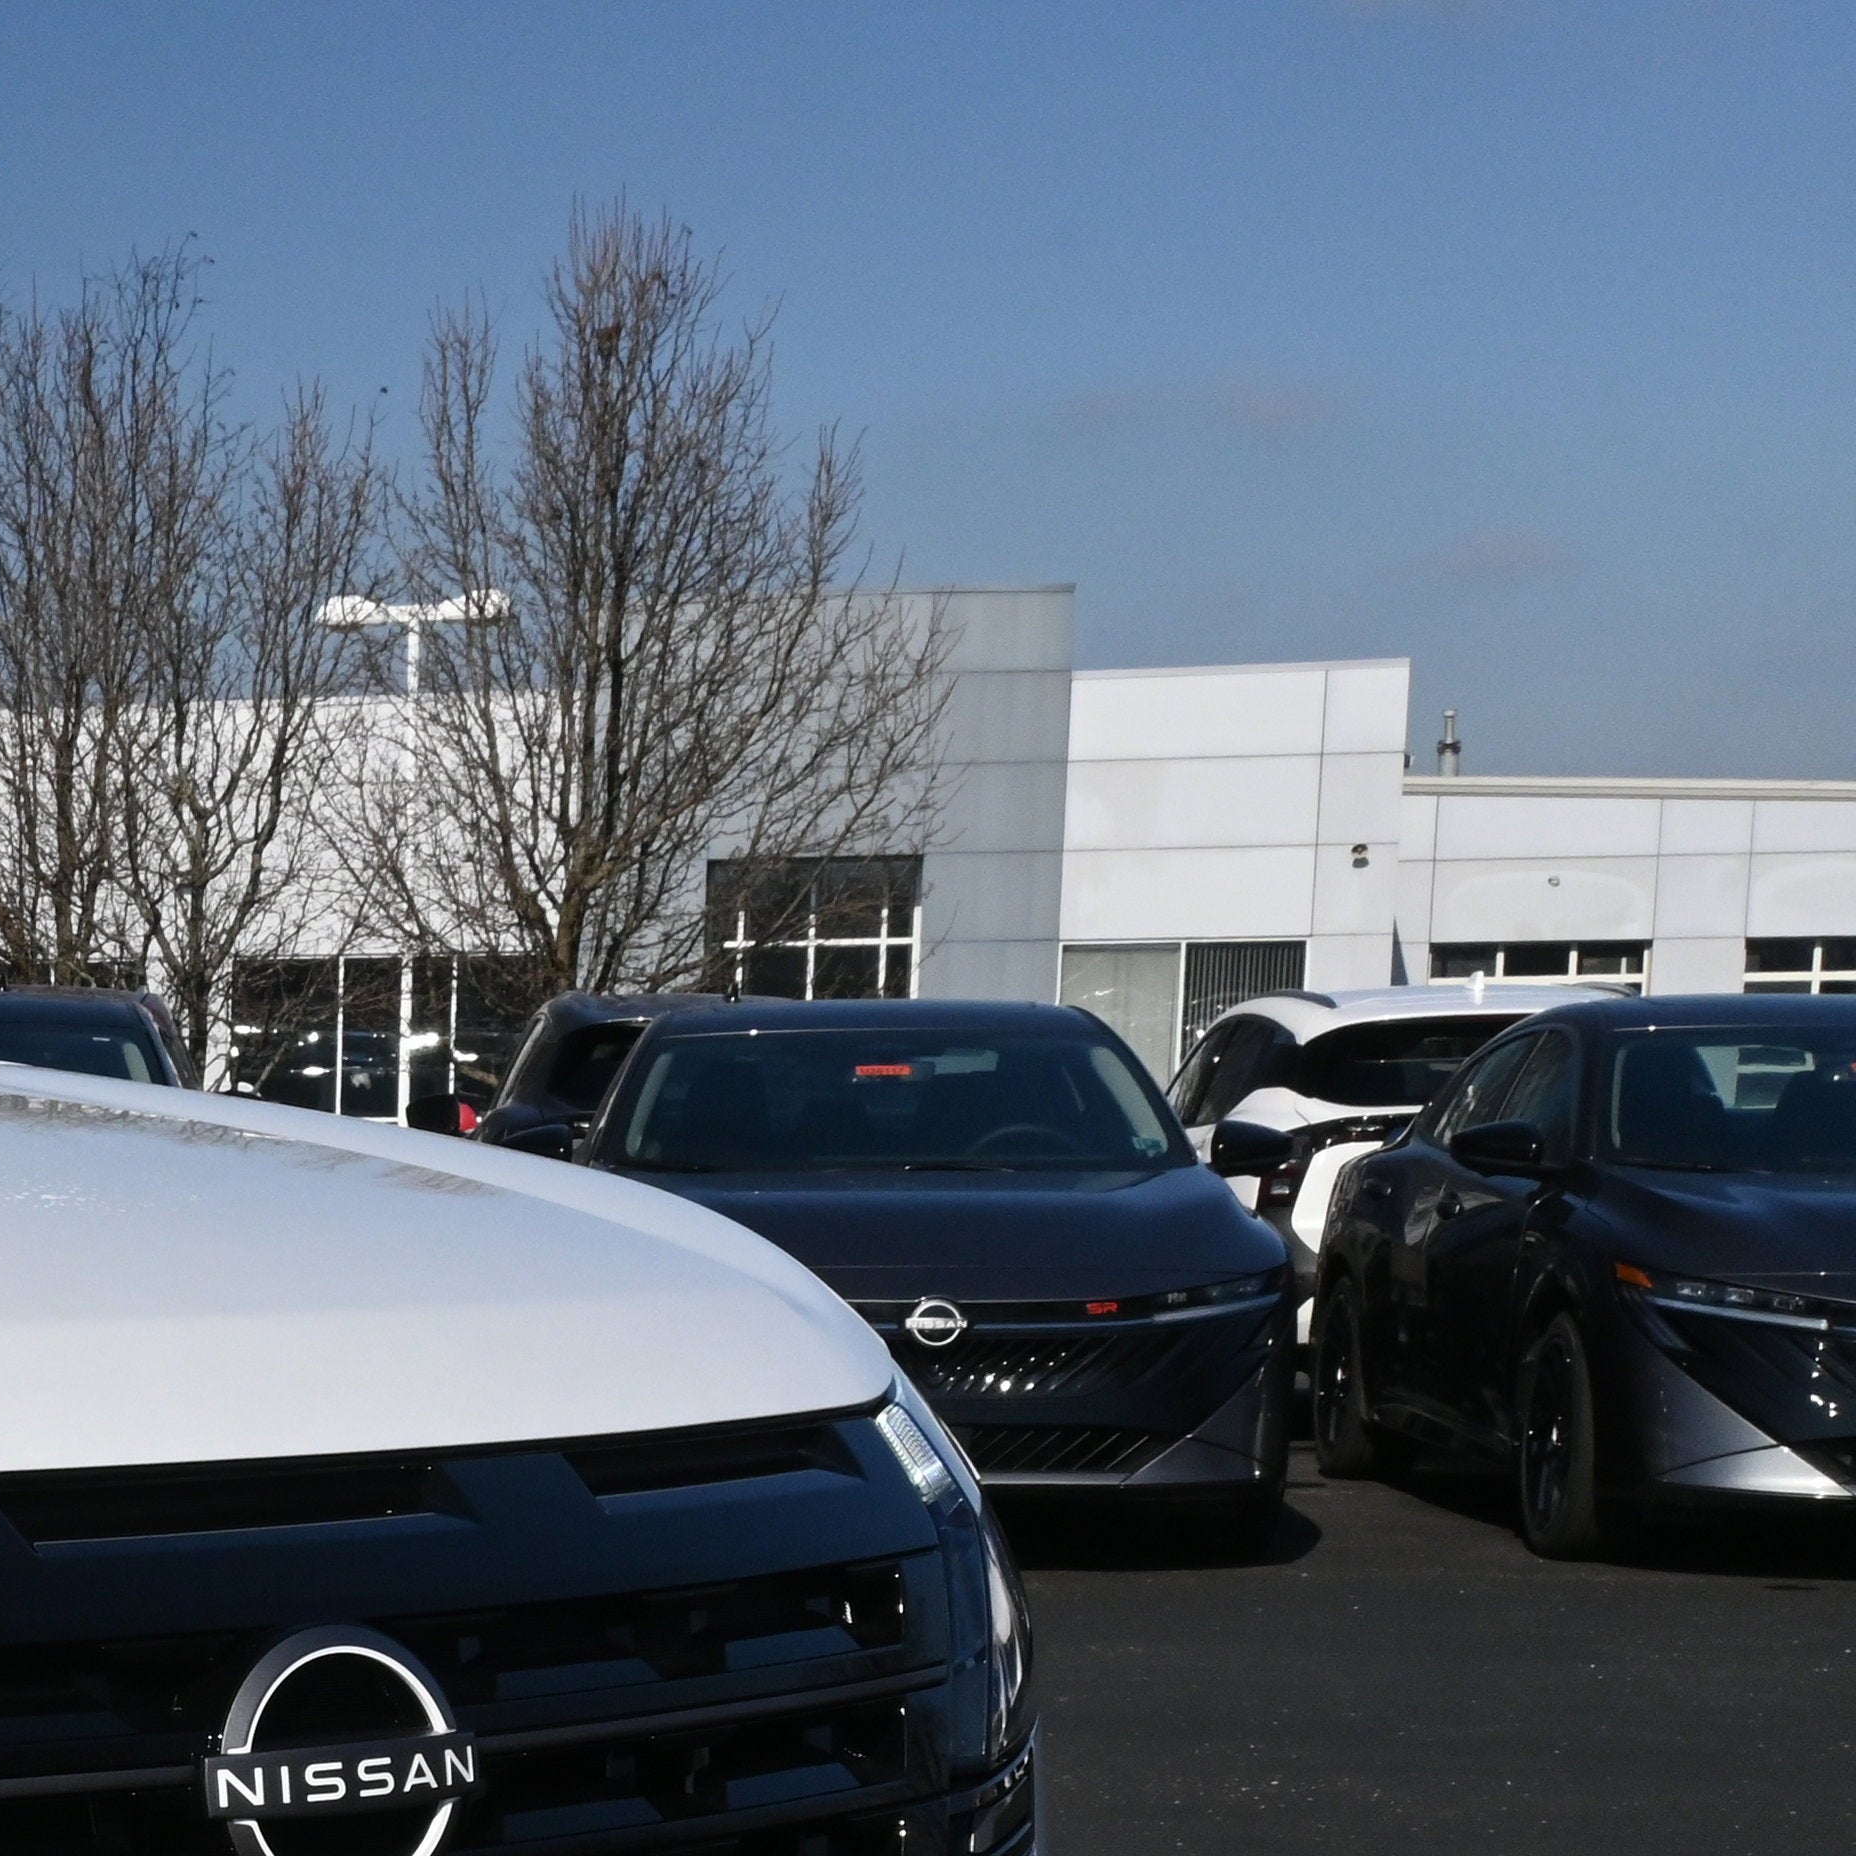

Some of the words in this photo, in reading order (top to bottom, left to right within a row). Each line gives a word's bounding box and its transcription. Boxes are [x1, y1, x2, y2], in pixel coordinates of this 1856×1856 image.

[1086, 1301, 1118, 1314] SR
[905, 1317, 968, 1330] NISSAN
[215, 1744, 476, 1809] NISSAN
